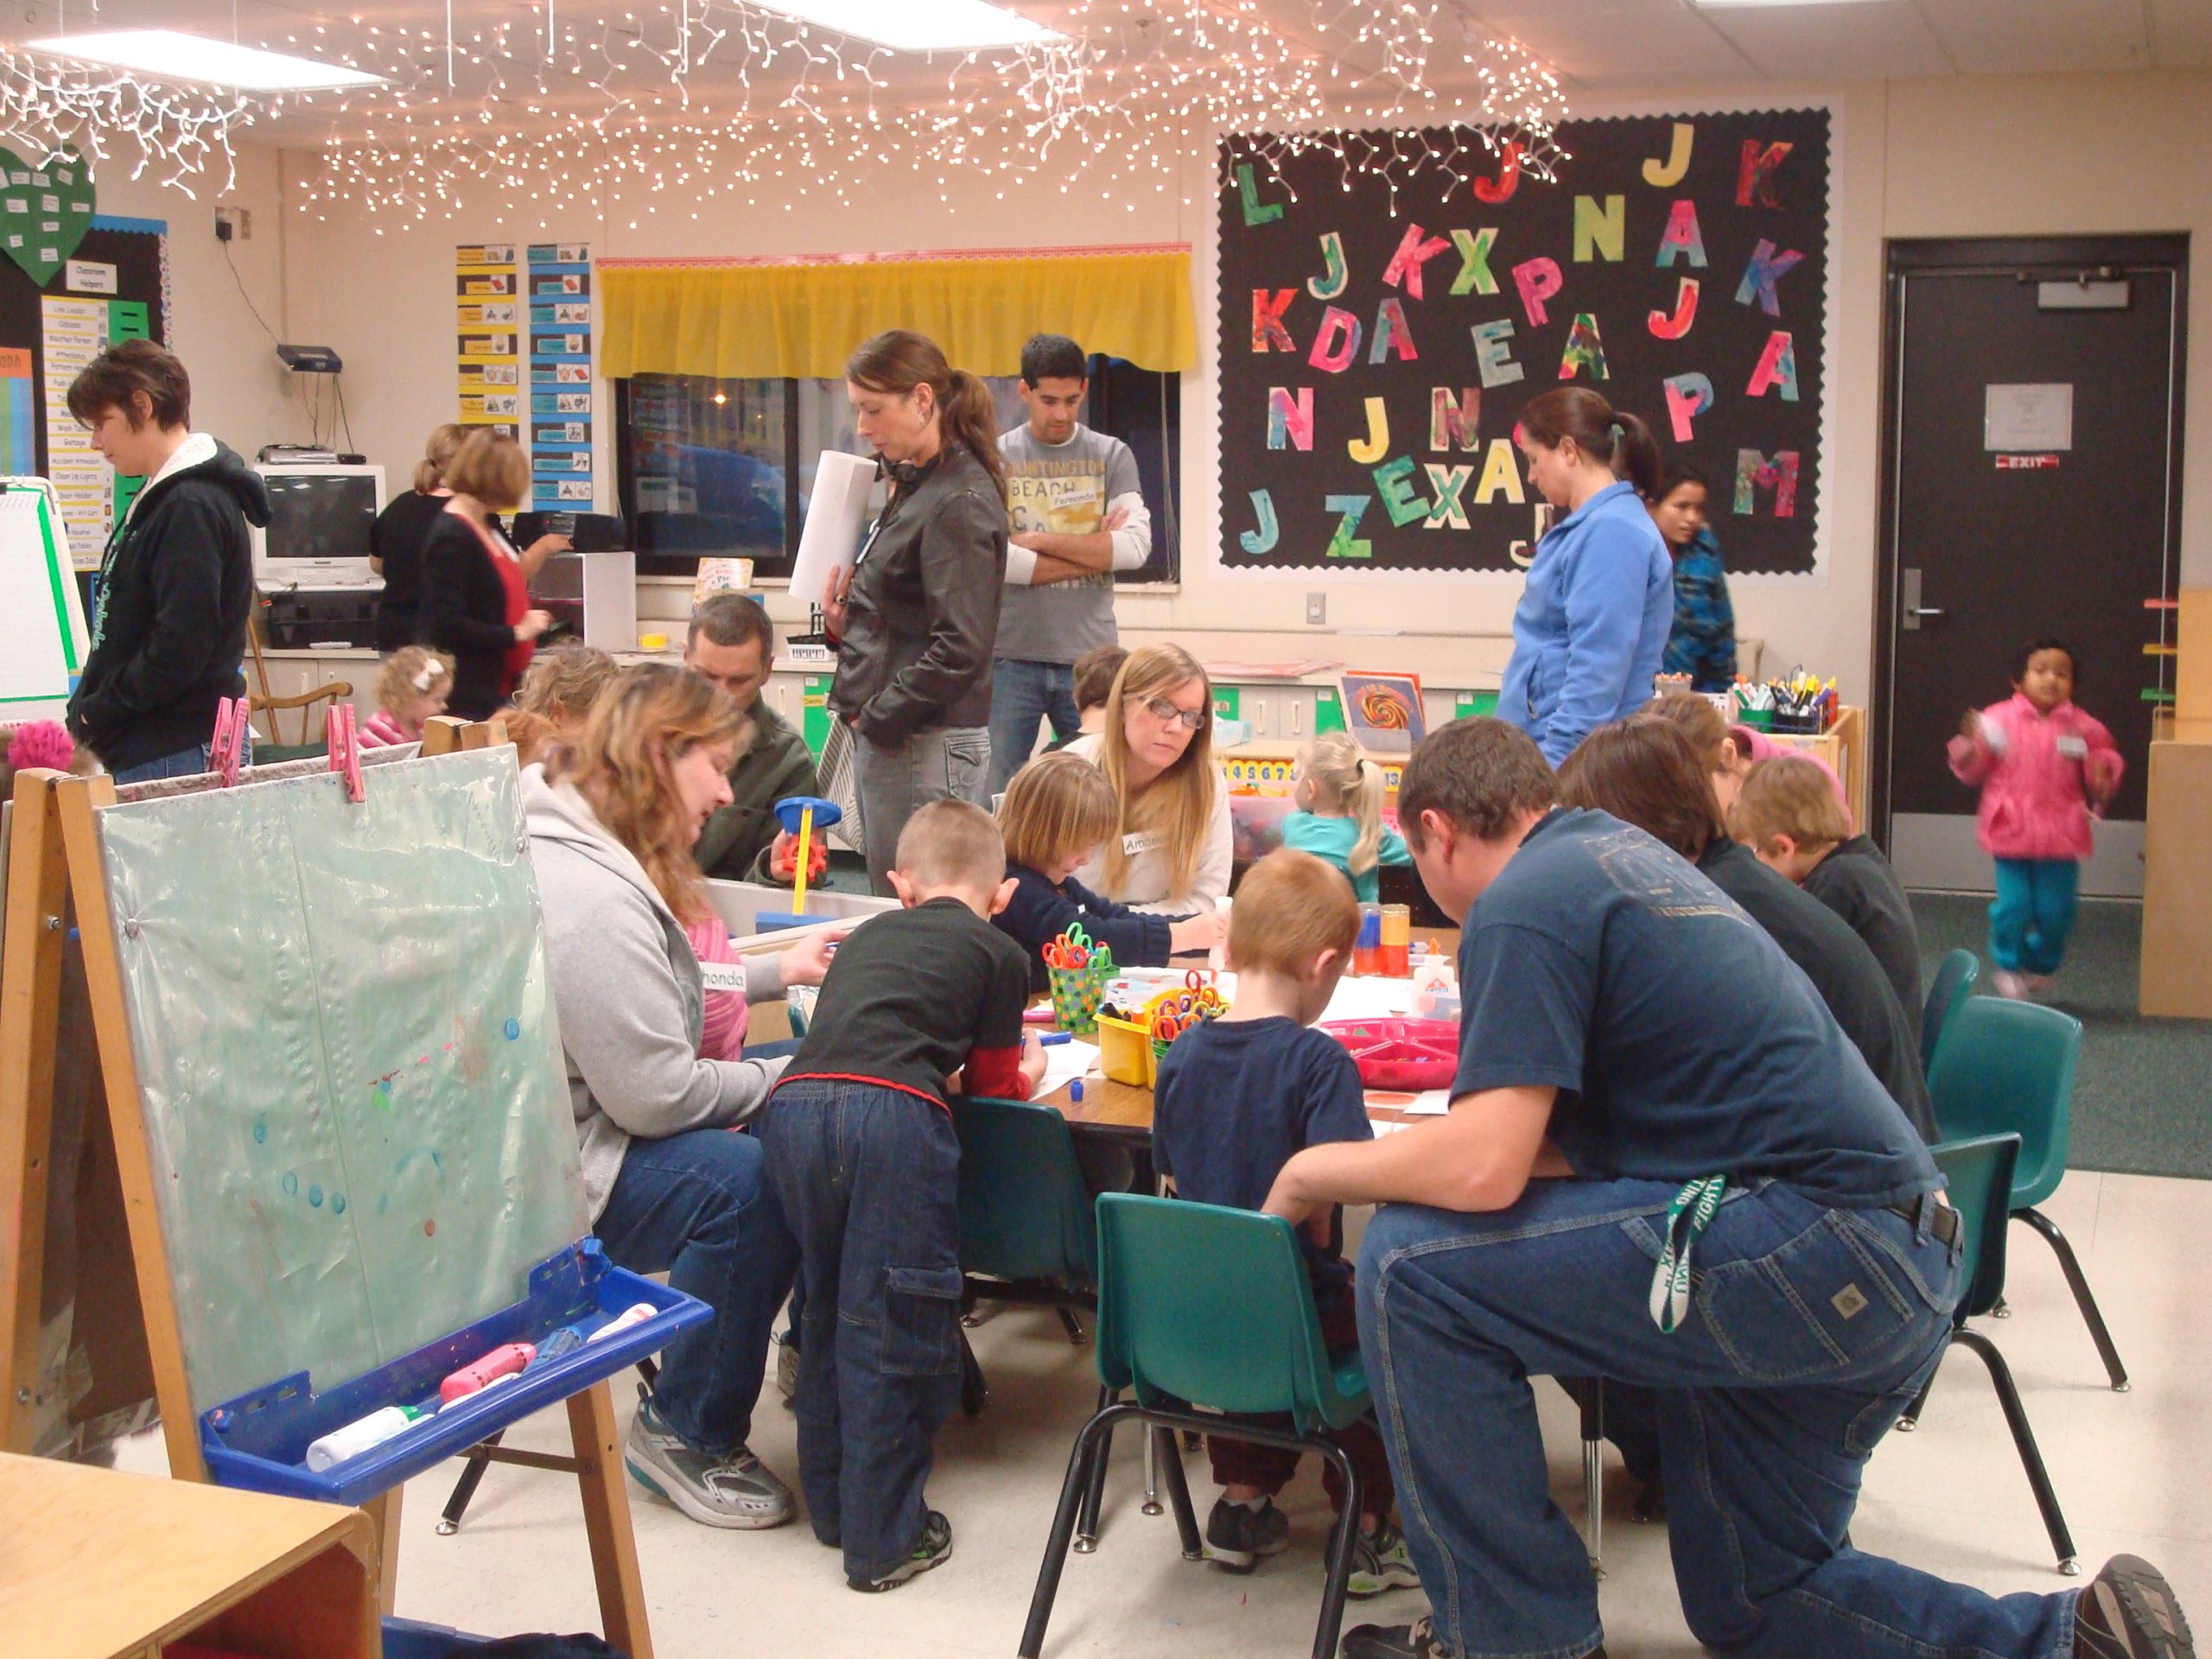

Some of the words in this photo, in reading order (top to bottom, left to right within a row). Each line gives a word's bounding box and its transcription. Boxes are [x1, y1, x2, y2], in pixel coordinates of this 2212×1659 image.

[1474, 141, 1524, 203] J
[1642, 123, 1694, 188] J
[1736, 139, 1793, 209] K
[1236, 163, 1283, 226] L
[1573, 194, 1624, 262] N
[1307, 232, 1348, 300] J
[1382, 223, 1452, 301] K
[1449, 227, 1499, 295] X
[1656, 200, 1707, 268] A
[1511, 257, 1563, 327] P
[1648, 276, 1700, 340] J
[1735, 238, 1805, 317] K
[1251, 289, 1298, 353] K
[1307, 306, 1362, 372] D
[1369, 297, 1419, 365] A
[1471, 319, 1524, 388] E
[1558, 313, 1610, 380] A
[1745, 331, 1800, 401] A
[1268, 386, 1313, 450] N
[1348, 397, 1389, 464] J
[1430, 386, 1480, 452] N
[1663, 372, 1713, 442] P
[1012, 479, 1077, 498] BEACH
[1373, 455, 1432, 528] E
[1474, 437, 1525, 505] A
[1733, 448, 1800, 517] M
[2009, 455, 2044, 468] EXIT
[1240, 488, 1279, 554] J
[1325, 494, 1371, 558] Z
[1423, 463, 1473, 529] X
[1510, 503, 1554, 567] J
[1233, 766, 1242, 779] 4
[1248, 766, 1255, 779] 5
[1262, 767, 1270, 779] 6
[1276, 767, 1284, 780] 7
[1384, 772, 1398, 785] 13
